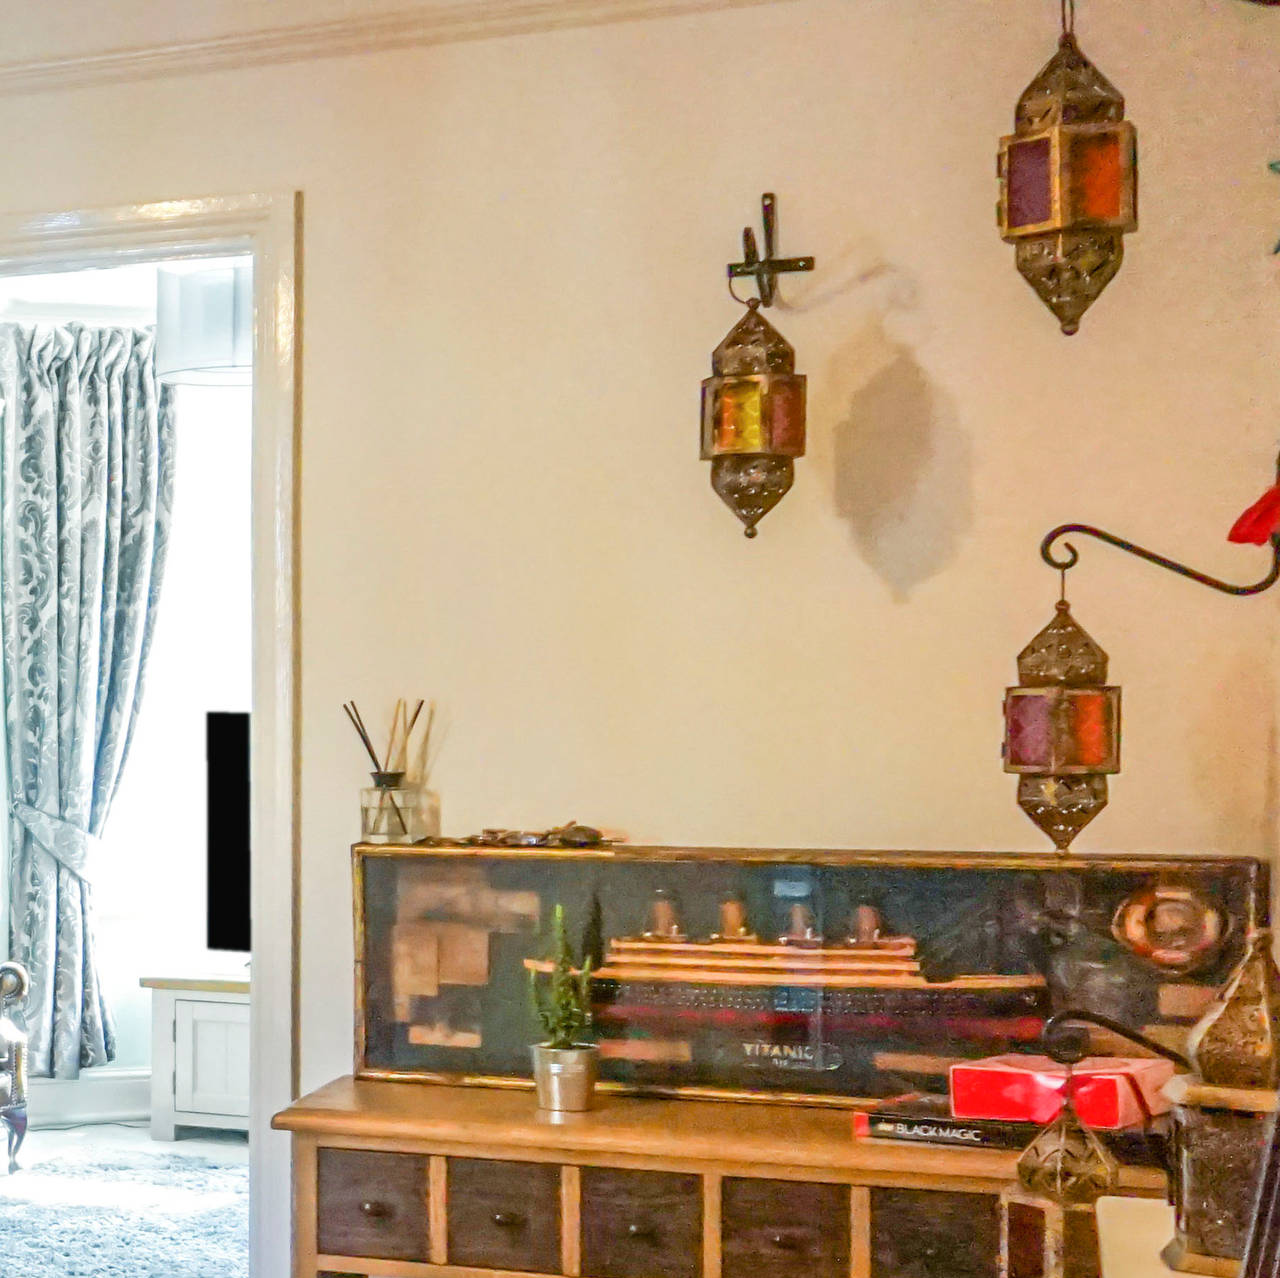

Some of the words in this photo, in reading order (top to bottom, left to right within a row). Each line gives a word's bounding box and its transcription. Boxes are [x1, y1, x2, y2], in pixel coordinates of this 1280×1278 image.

[742, 1043, 814, 1060] TITANIC
[896, 1123, 938, 1136] BLACK
[939, 1127, 982, 1141] MAGIC
